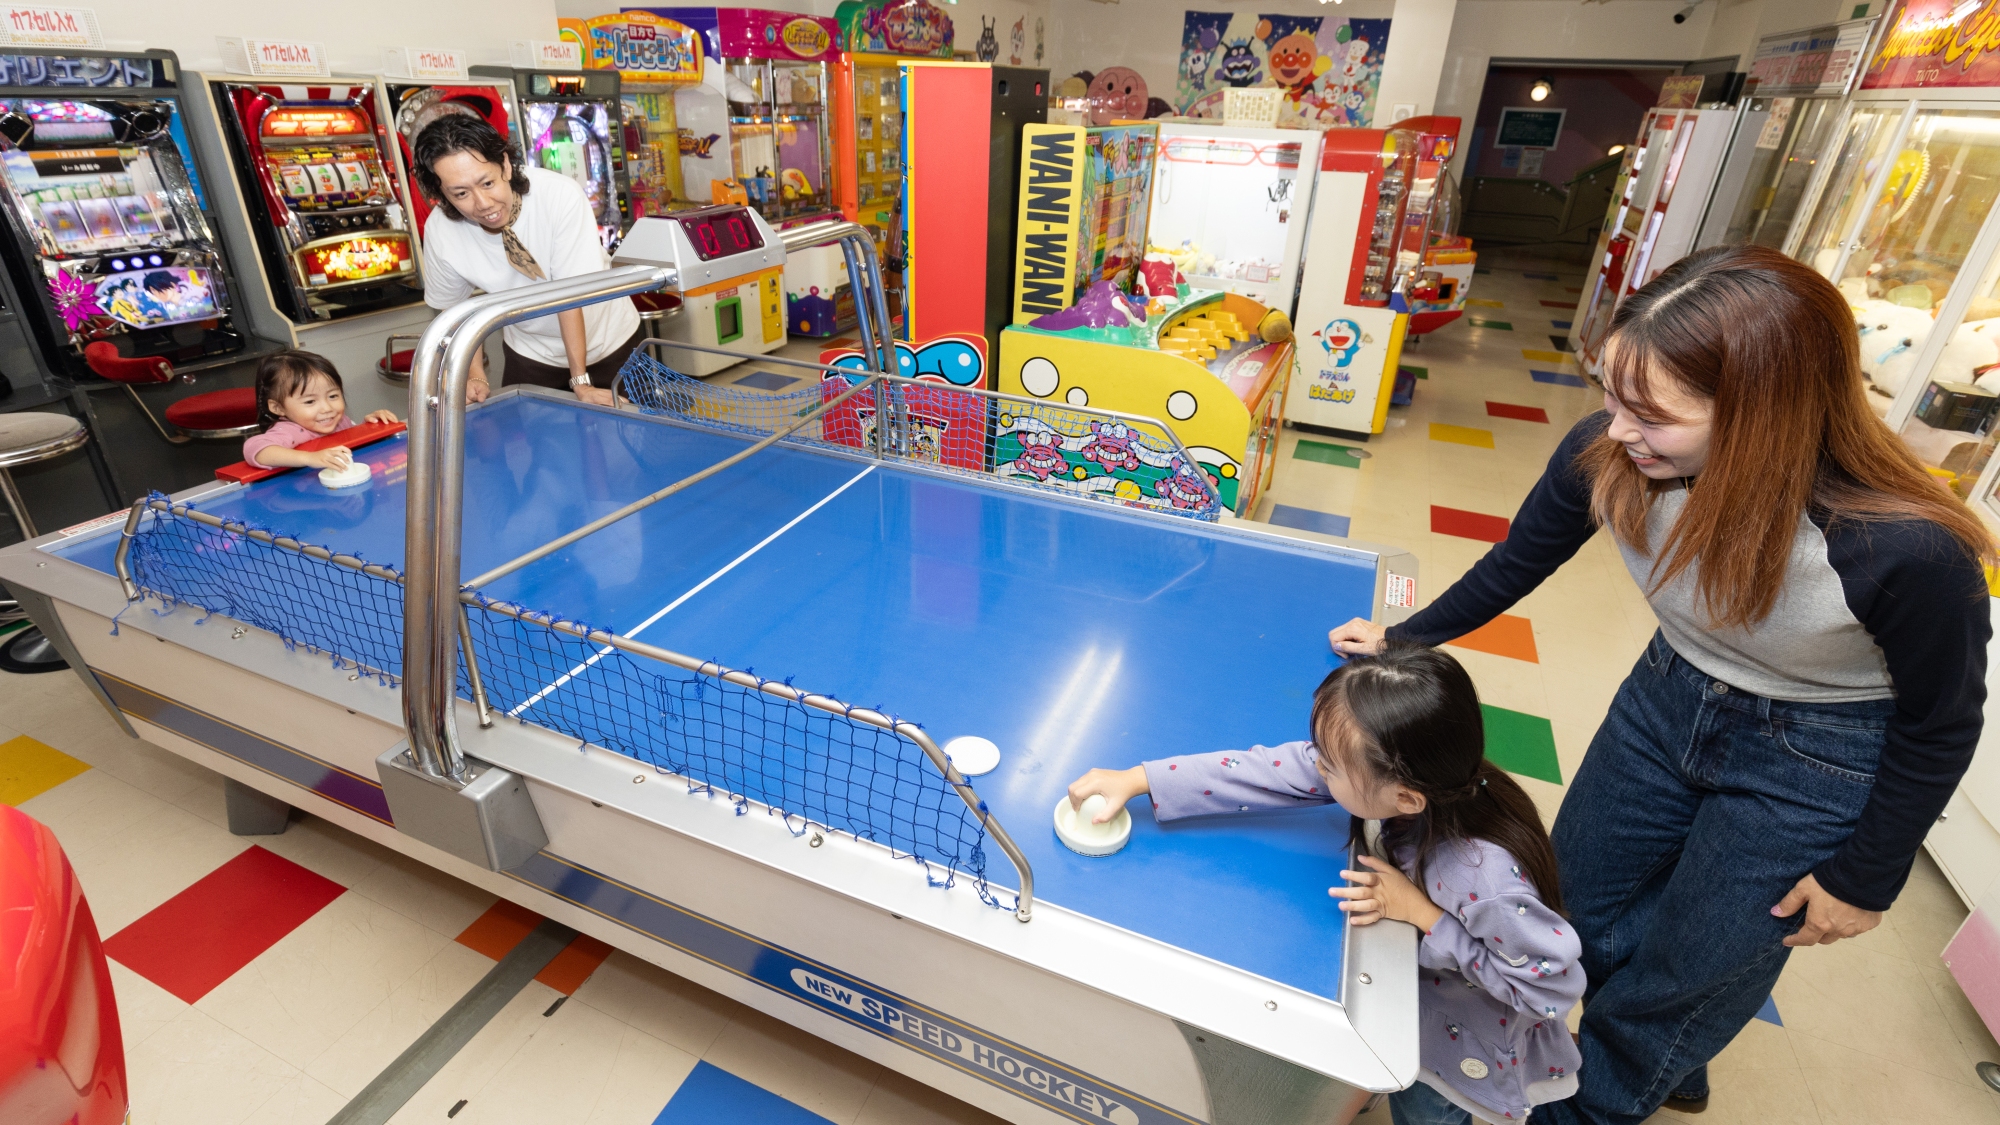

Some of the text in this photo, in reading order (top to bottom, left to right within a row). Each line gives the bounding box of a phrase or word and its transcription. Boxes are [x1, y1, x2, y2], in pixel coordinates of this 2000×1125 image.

[10, 9, 78, 32] カプセル入れ
[629, 14, 656, 22] namco
[629, 25, 653, 37] 目方で
[262, 44, 311, 62] カプセル入れ
[420, 52, 456, 69] カプセル入れ
[543, 44, 572, 60] カプセル入れ
[727, 217, 750, 249] 0
[1021, 132, 1076, 316] WANI-WANI
[1308, 384, 1356, 404] はたあげ
[805, 975, 1121, 1120] NEW SPEED HOCKEY
